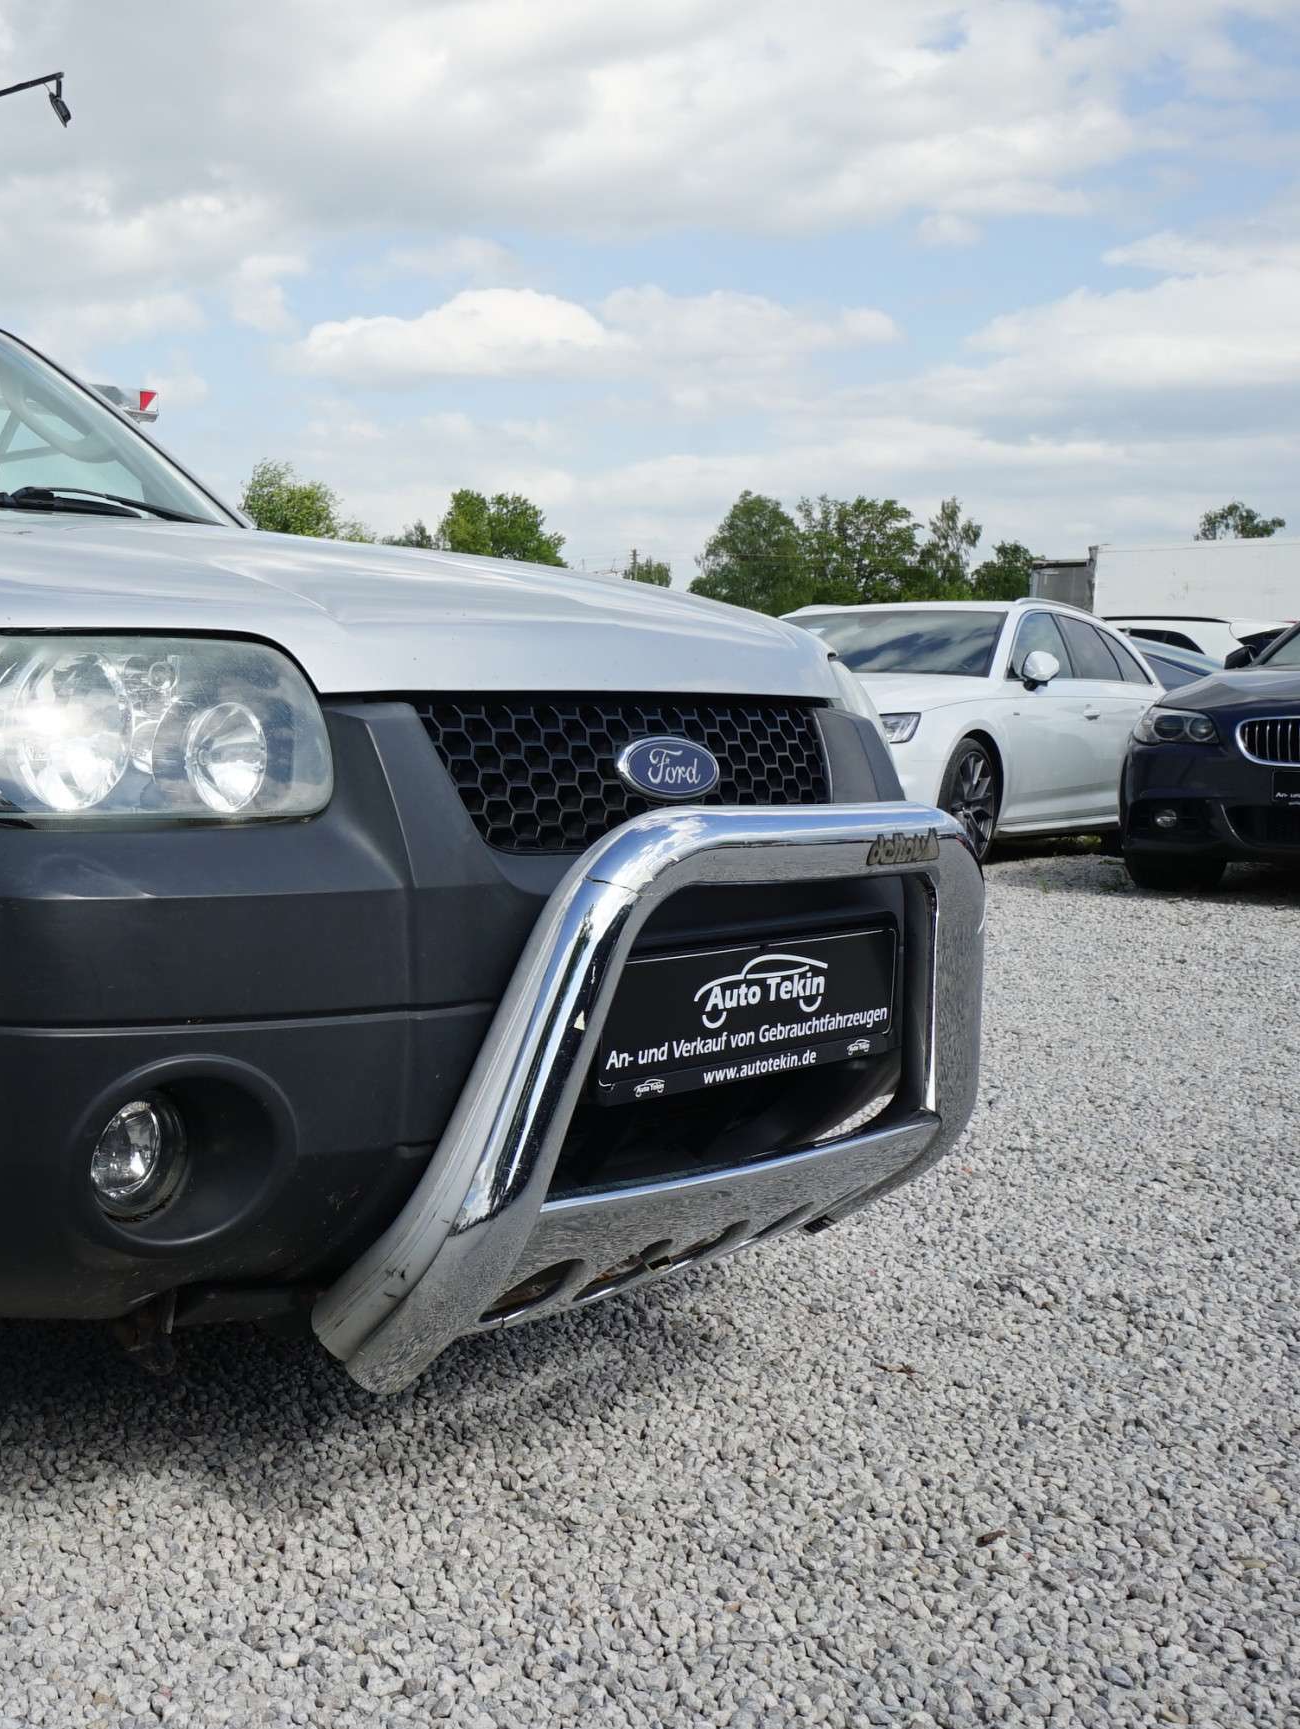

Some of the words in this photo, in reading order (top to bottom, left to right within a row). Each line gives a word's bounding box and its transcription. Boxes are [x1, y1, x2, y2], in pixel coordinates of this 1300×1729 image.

[647, 747, 701, 785] Ford
[704, 983, 761, 1012] Auto
[767, 971, 825, 1001] Tekin
[605, 1050, 634, 1070] An-
[638, 1042, 669, 1065] und
[672, 1031, 728, 1059] Verkauf
[730, 1032, 755, 1049] von
[759, 1007, 888, 1043] Gebrauchtfahrzeugen
[703, 1050, 817, 1085] www.autotekin.de
